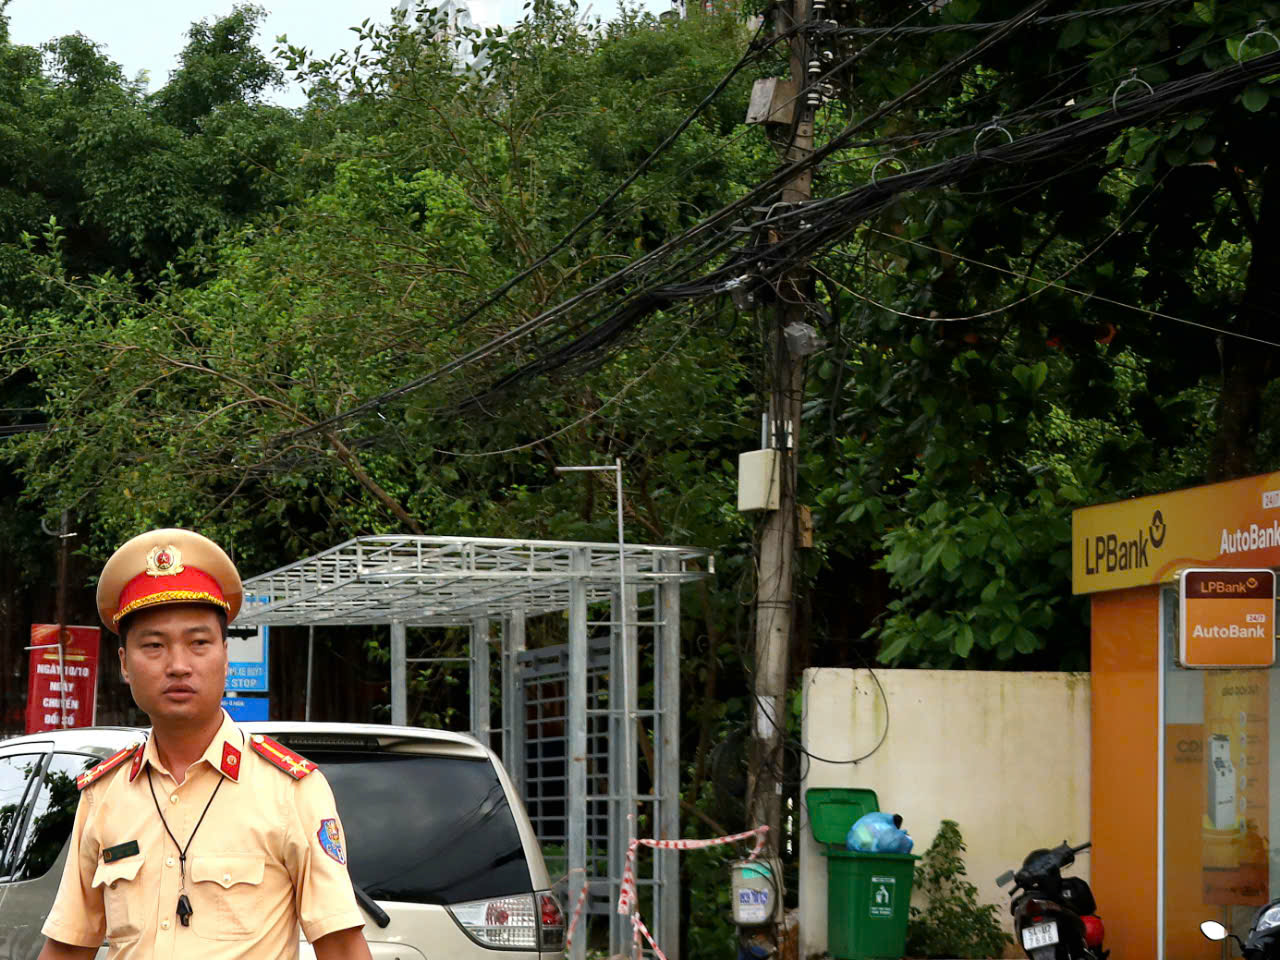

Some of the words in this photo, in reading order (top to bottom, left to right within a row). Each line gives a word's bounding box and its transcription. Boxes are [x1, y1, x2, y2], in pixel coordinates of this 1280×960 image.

[1220, 520, 1280, 555] AutoBank
[1085, 529, 1149, 575] LPBank
[1200, 581, 1247, 593] LPBank
[1192, 625, 1265, 639] AutoBank
[64, 666, 89, 677] 10/10
[231, 678, 257, 689] STOP
